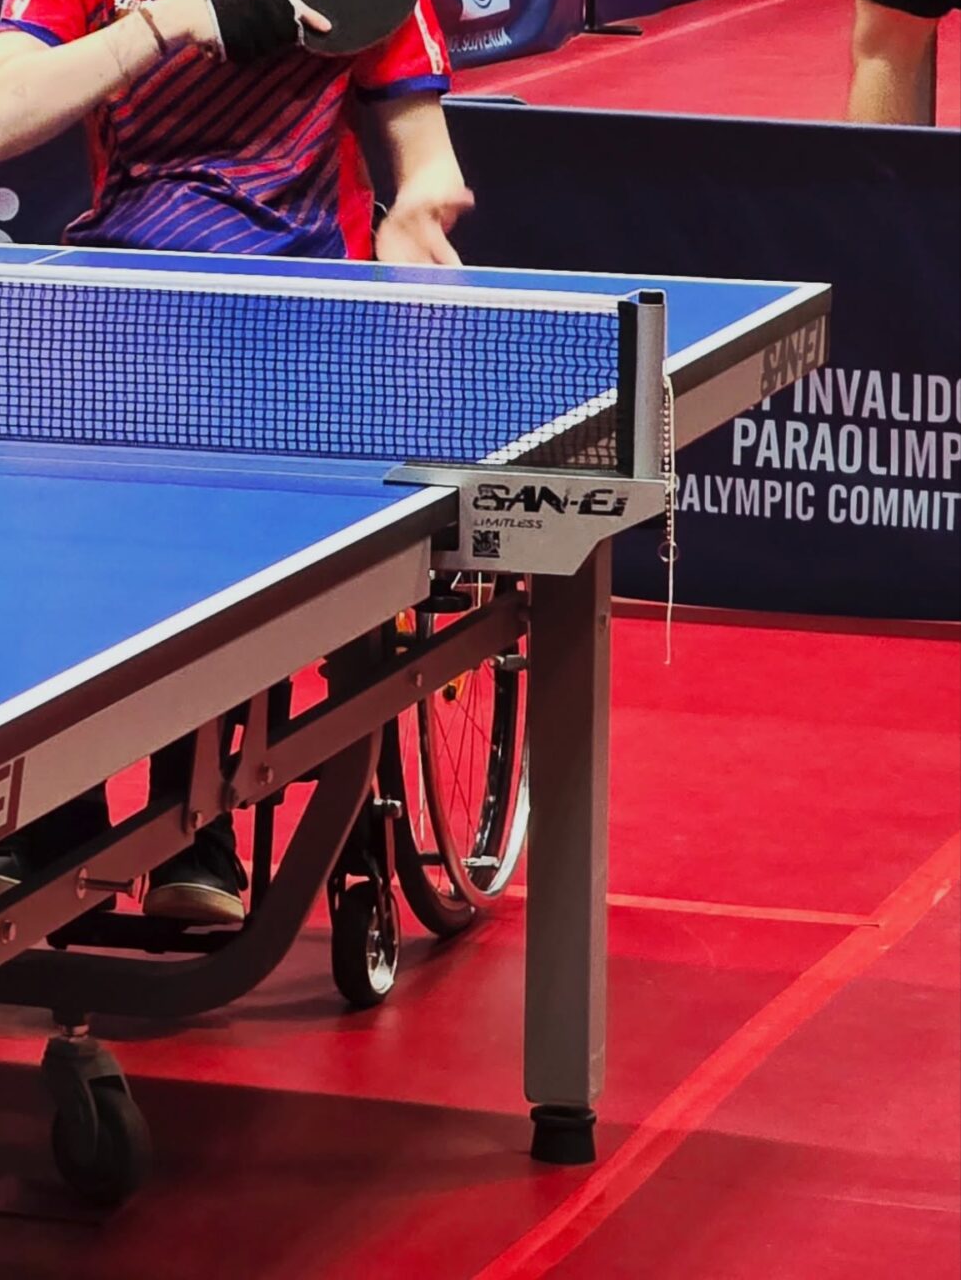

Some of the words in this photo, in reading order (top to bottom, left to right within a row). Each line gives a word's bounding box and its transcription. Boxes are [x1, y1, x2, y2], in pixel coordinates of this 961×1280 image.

[732, 417, 961, 480] PARAOLIMP
[473, 518, 544, 530] LIMITLESS
[828, 483, 961, 531] COMMIT
